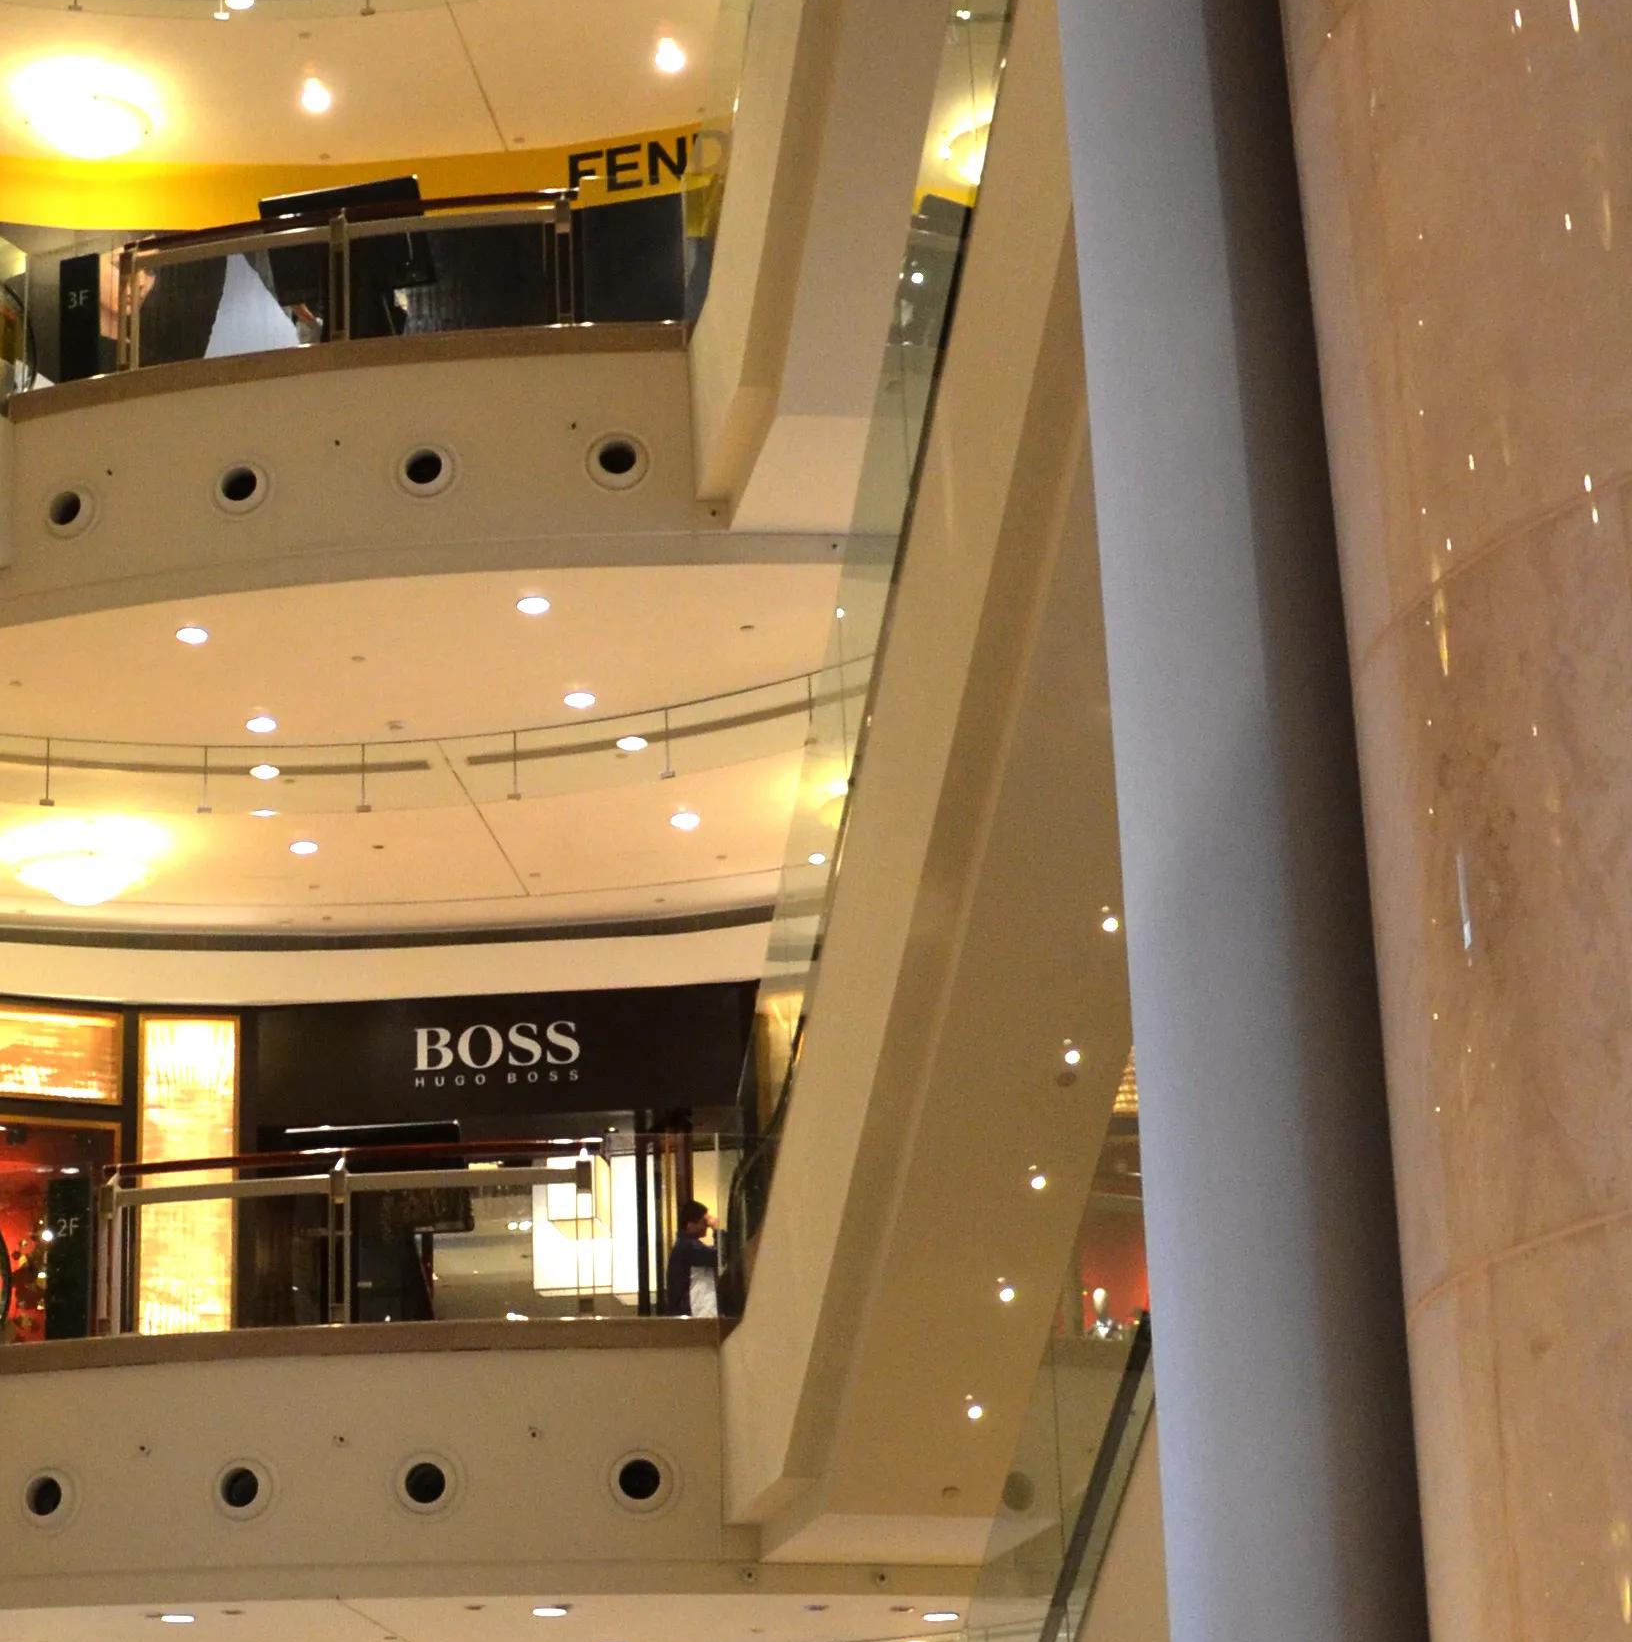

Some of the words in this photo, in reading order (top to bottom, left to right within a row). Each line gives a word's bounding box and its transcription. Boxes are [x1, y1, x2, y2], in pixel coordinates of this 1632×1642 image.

[68, 289, 89, 309] 3F
[414, 1020, 580, 1071] BOSS
[415, 1074, 486, 1088] HUGO
[507, 1069, 579, 1084] BOSS
[57, 1217, 80, 1237] 2F
